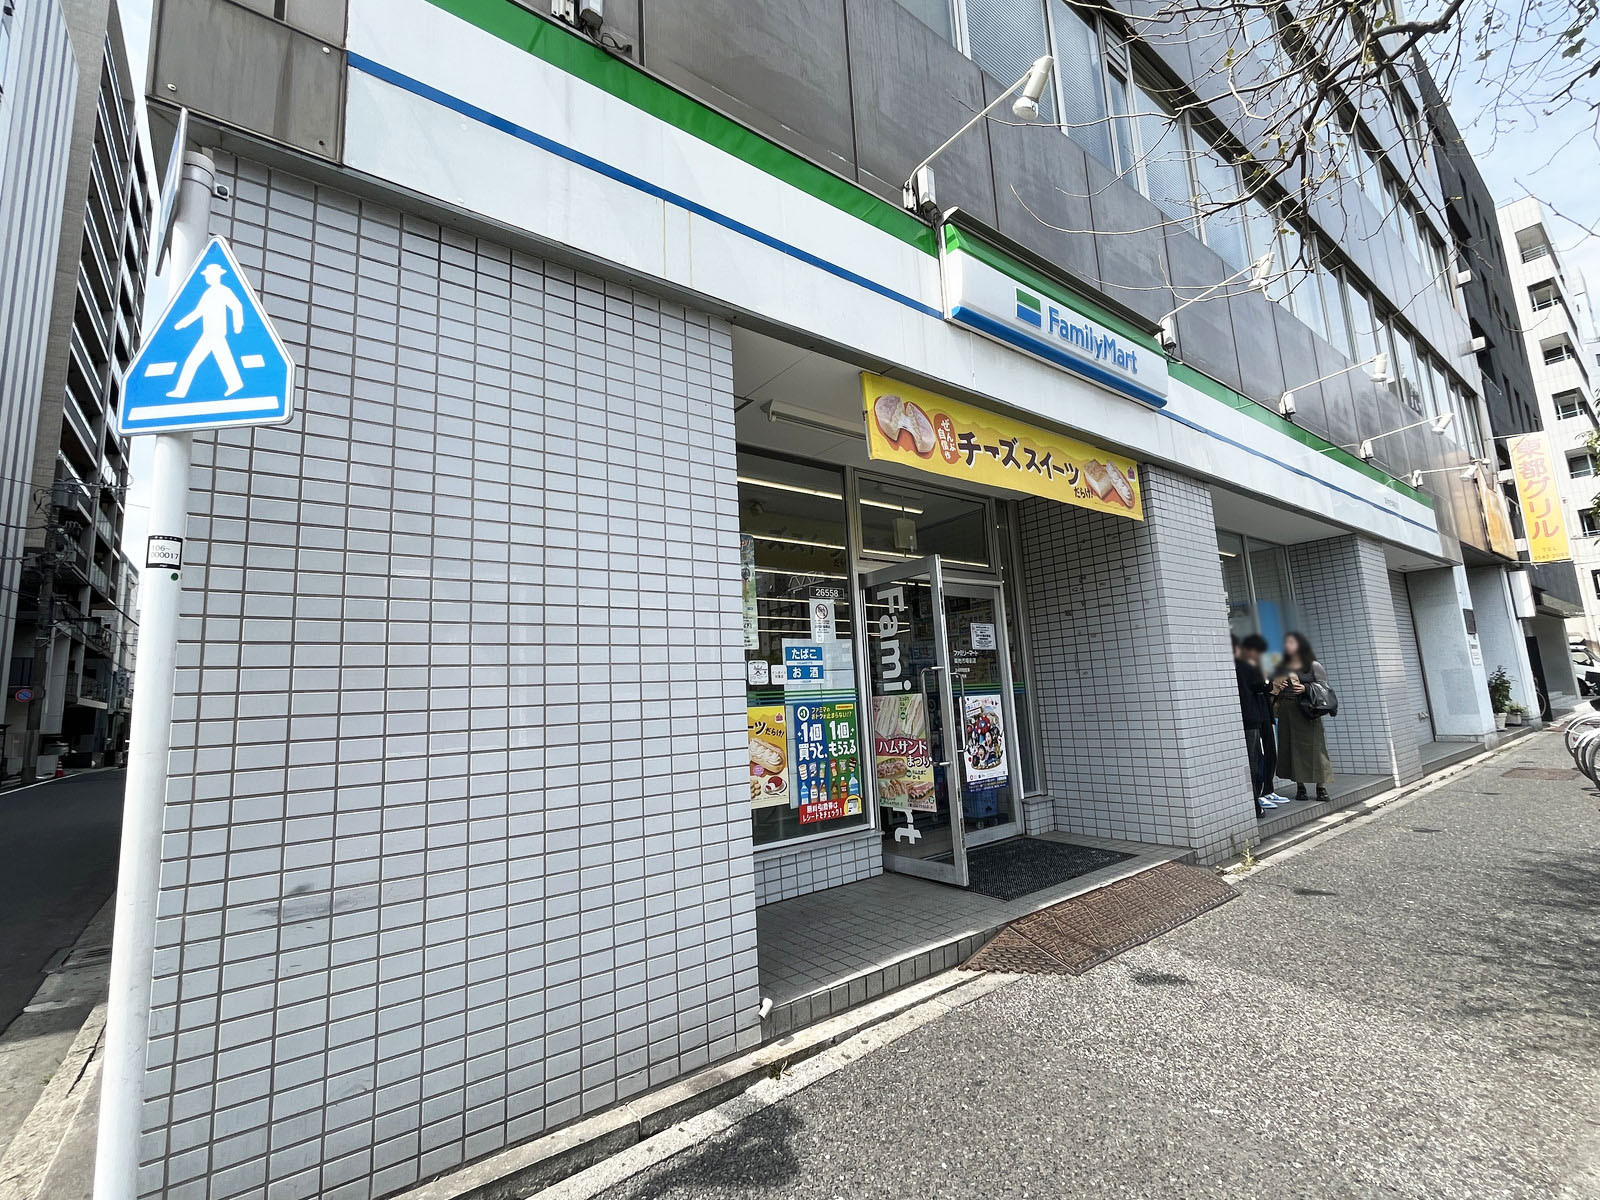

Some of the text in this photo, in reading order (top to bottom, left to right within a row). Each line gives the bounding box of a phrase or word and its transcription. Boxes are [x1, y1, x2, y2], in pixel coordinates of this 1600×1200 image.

[1048, 304, 1138, 375] FamilyMart
[957, 430, 1081, 486] チーズスイーツ
[815, 588, 839, 598] 26558
[791, 647, 817, 660] たばこ
[829, 739, 857, 757] もらえる
[878, 740, 928, 755] ハムサンド
